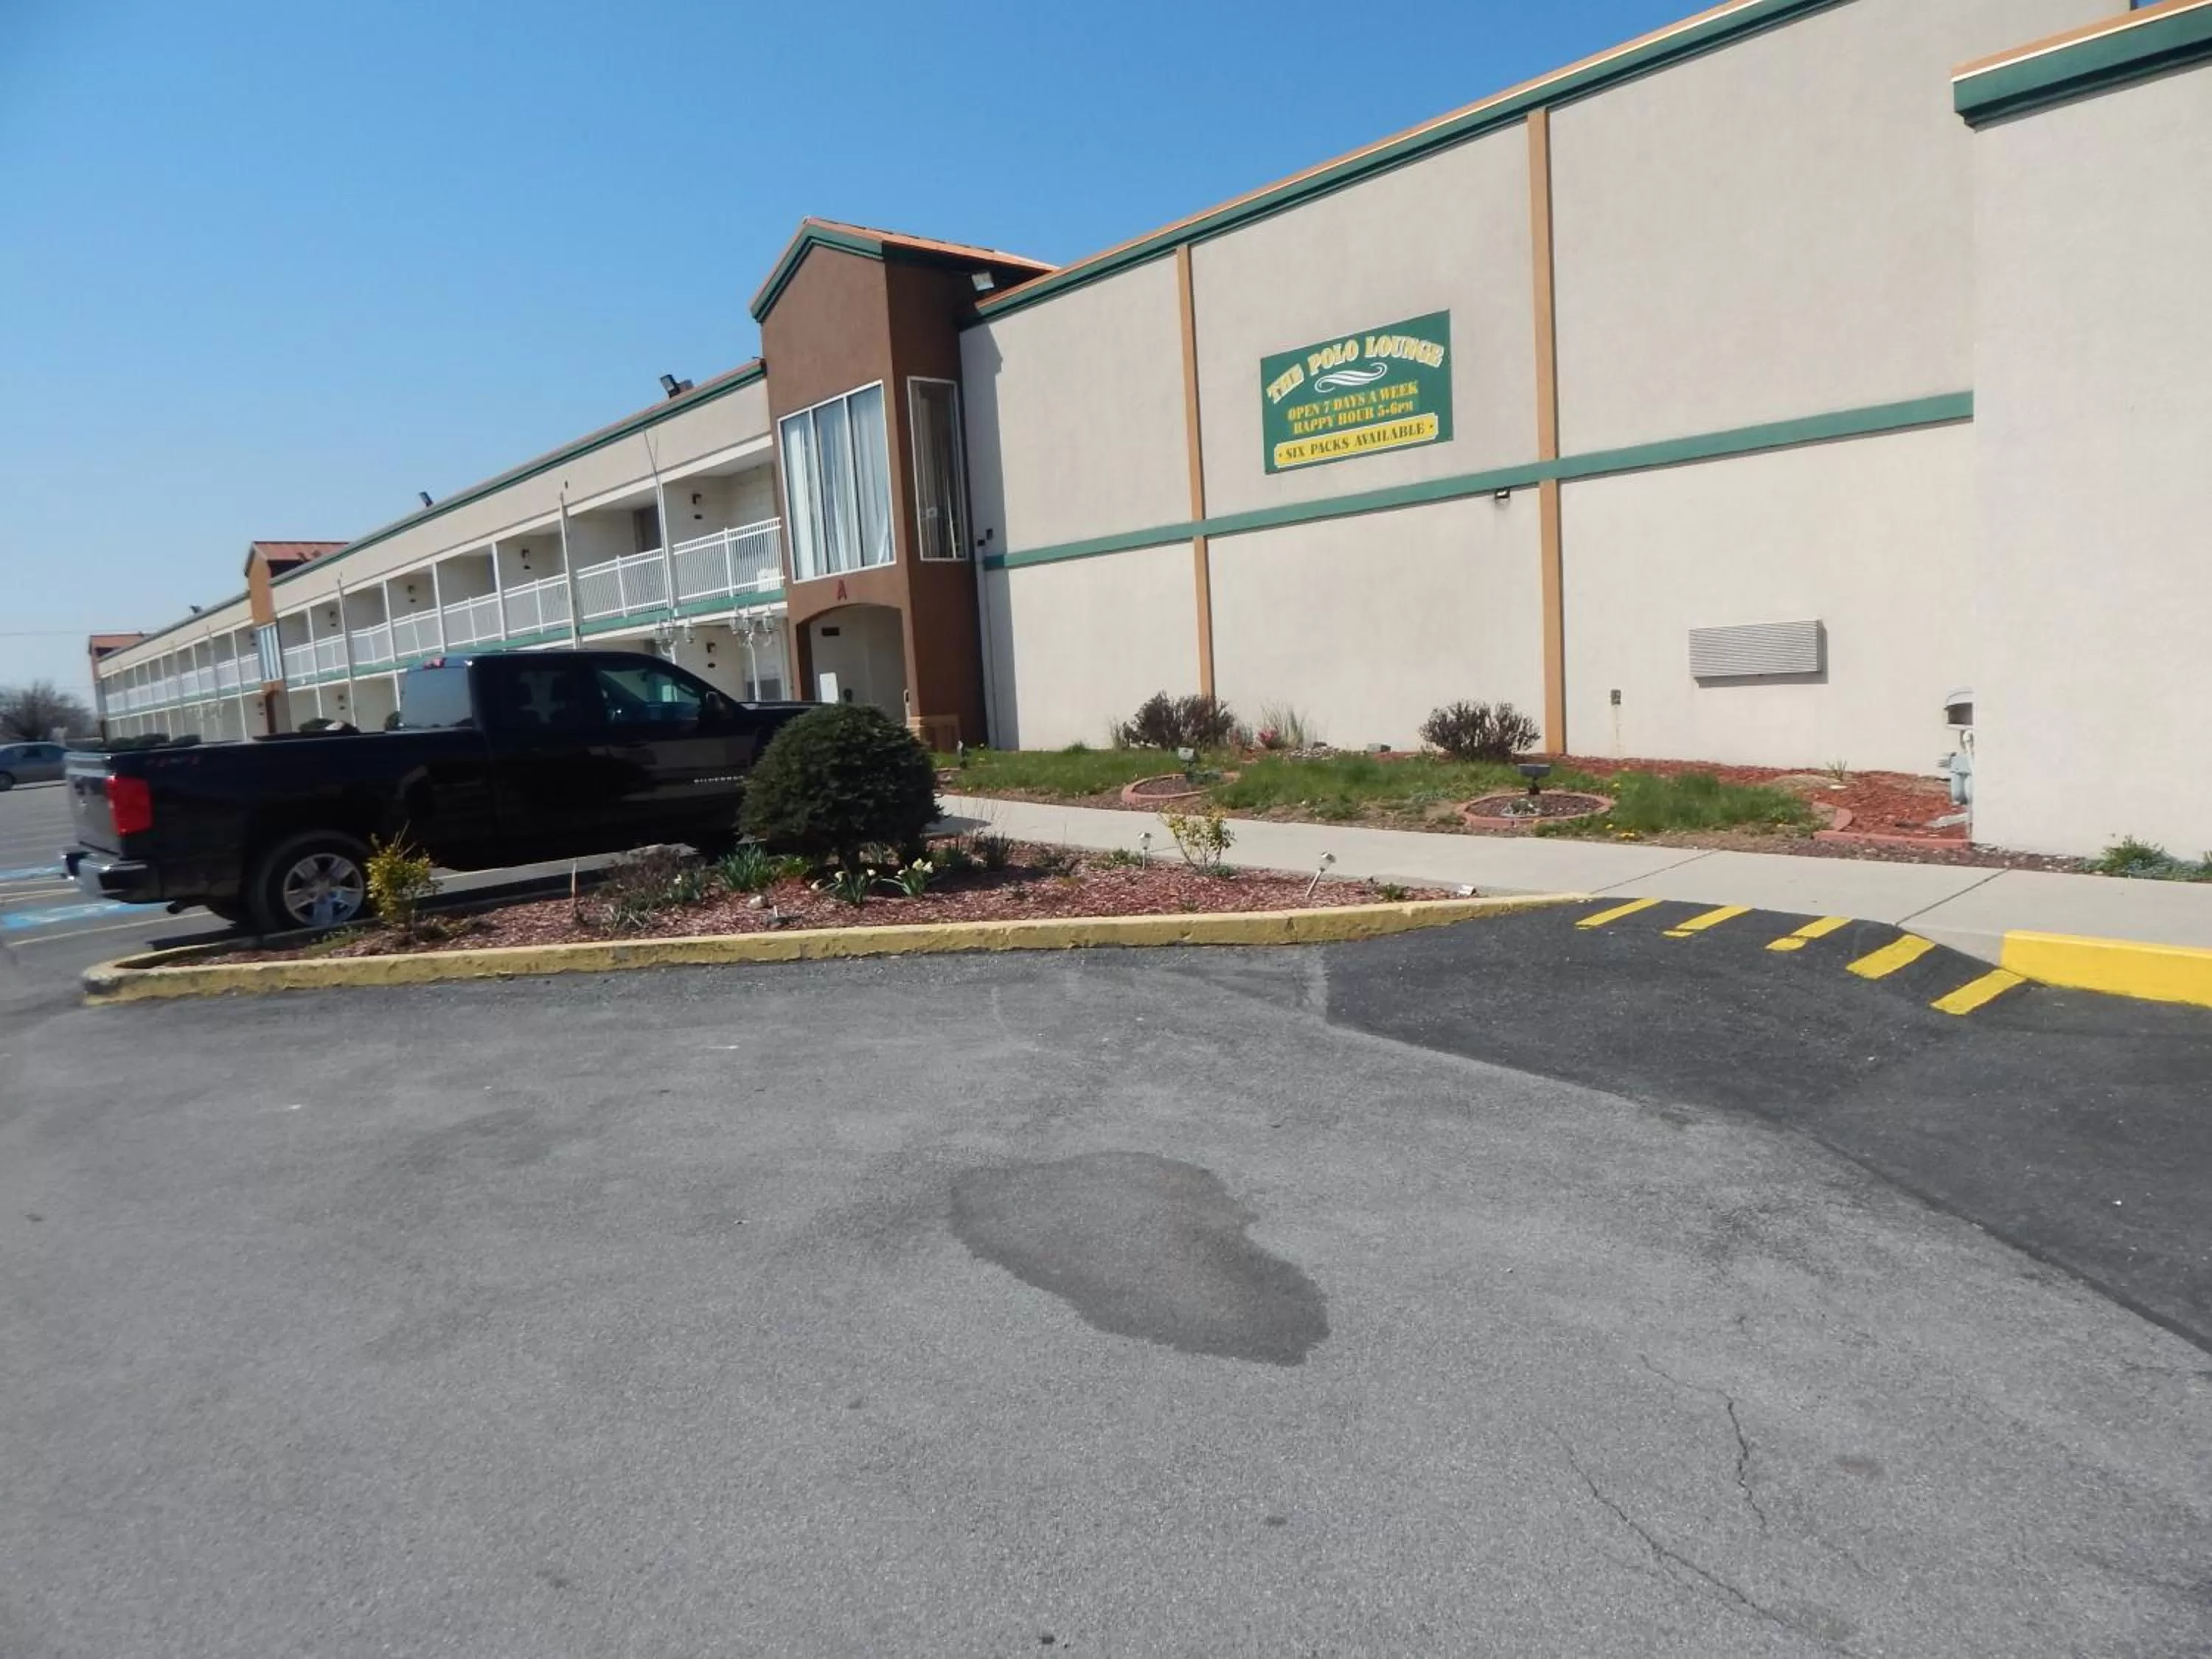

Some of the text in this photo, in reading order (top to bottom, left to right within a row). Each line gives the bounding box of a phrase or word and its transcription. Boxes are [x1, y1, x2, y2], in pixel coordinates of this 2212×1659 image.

[1267, 334, 1444, 404] THE POLO LOUNGE
[1288, 379, 1419, 421] OPEN 7 DAYS A WEEK
[1286, 421, 1425, 459] SIX PACKS AVAILABLE
[1294, 415, 1334, 435] HAPPY
[1338, 407, 1374, 425] HOUR
[837, 579, 847, 602] A
